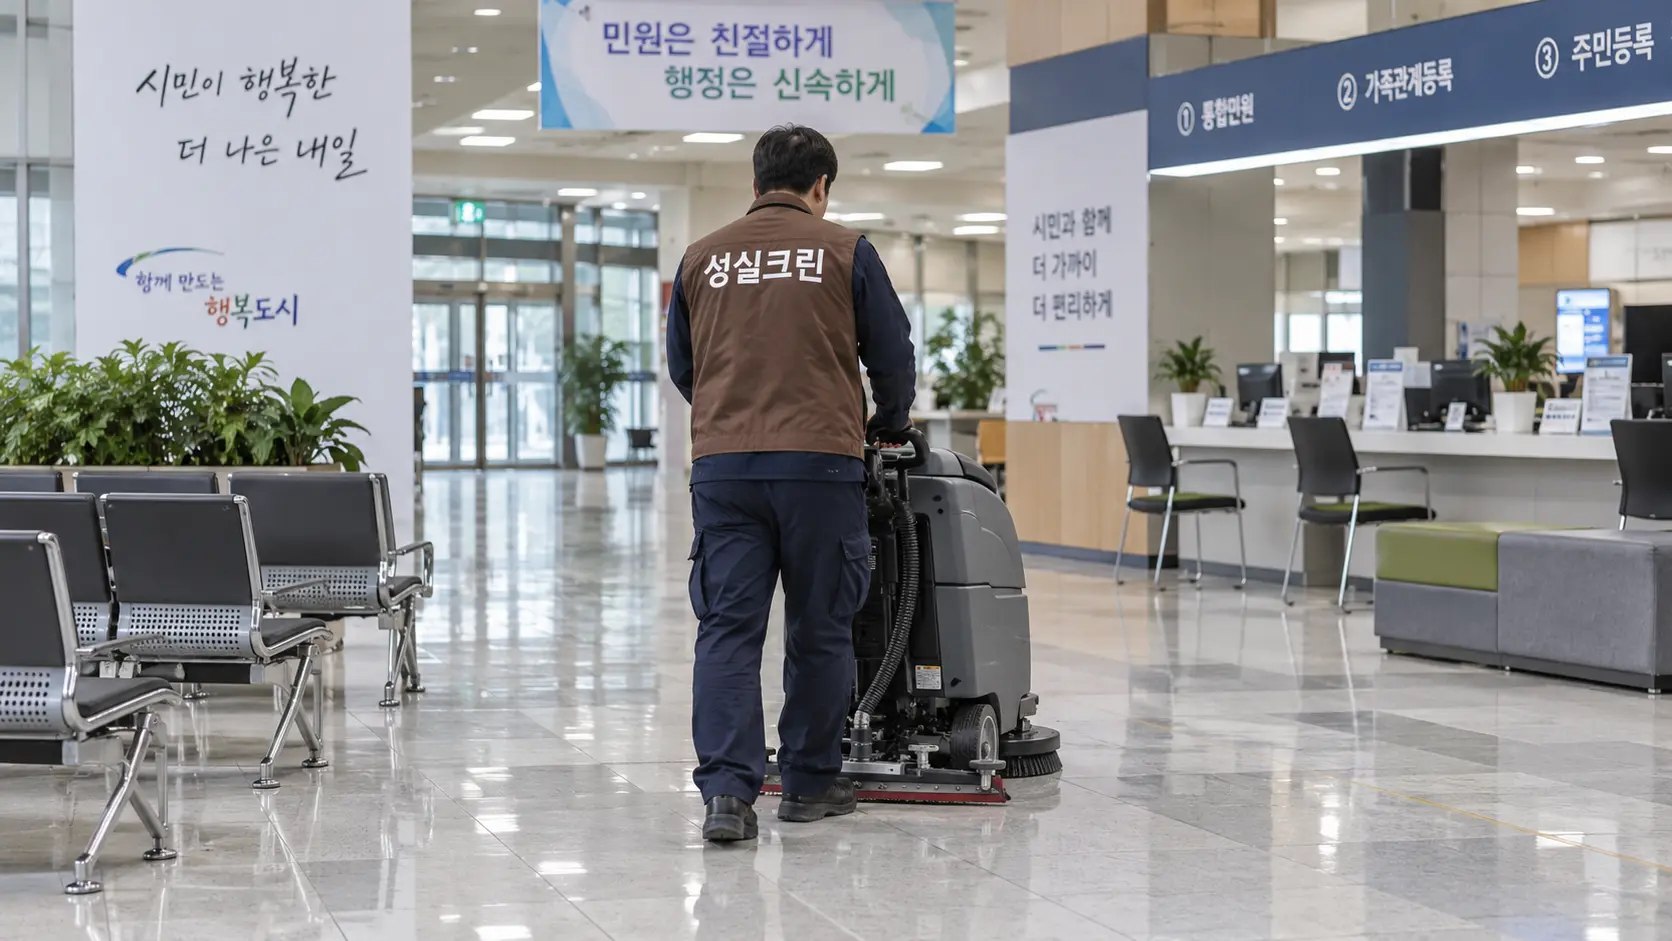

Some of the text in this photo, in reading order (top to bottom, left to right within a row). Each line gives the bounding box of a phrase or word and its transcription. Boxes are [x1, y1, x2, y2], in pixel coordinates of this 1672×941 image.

[604, 22, 832, 58] 민원은 친절하게
[1572, 22, 1654, 71] 주민등록
[136, 57, 336, 118] 시민이 행복한
[665, 66, 894, 102] 행정은 신속하게
[1365, 58, 1453, 103] 가족관계등록
[1201, 93, 1253, 130] 통합민원
[178, 128, 367, 181] 더 나은 내일
[1033, 206, 1111, 240] 시민과 함께
[137, 271, 223, 293] 함께 만도는
[704, 248, 824, 288] 성실크린
[1033, 249, 1096, 280] 더 가까이
[206, 293, 297, 328] 행복도시
[1033, 290, 1112, 321] 더 편리하게
